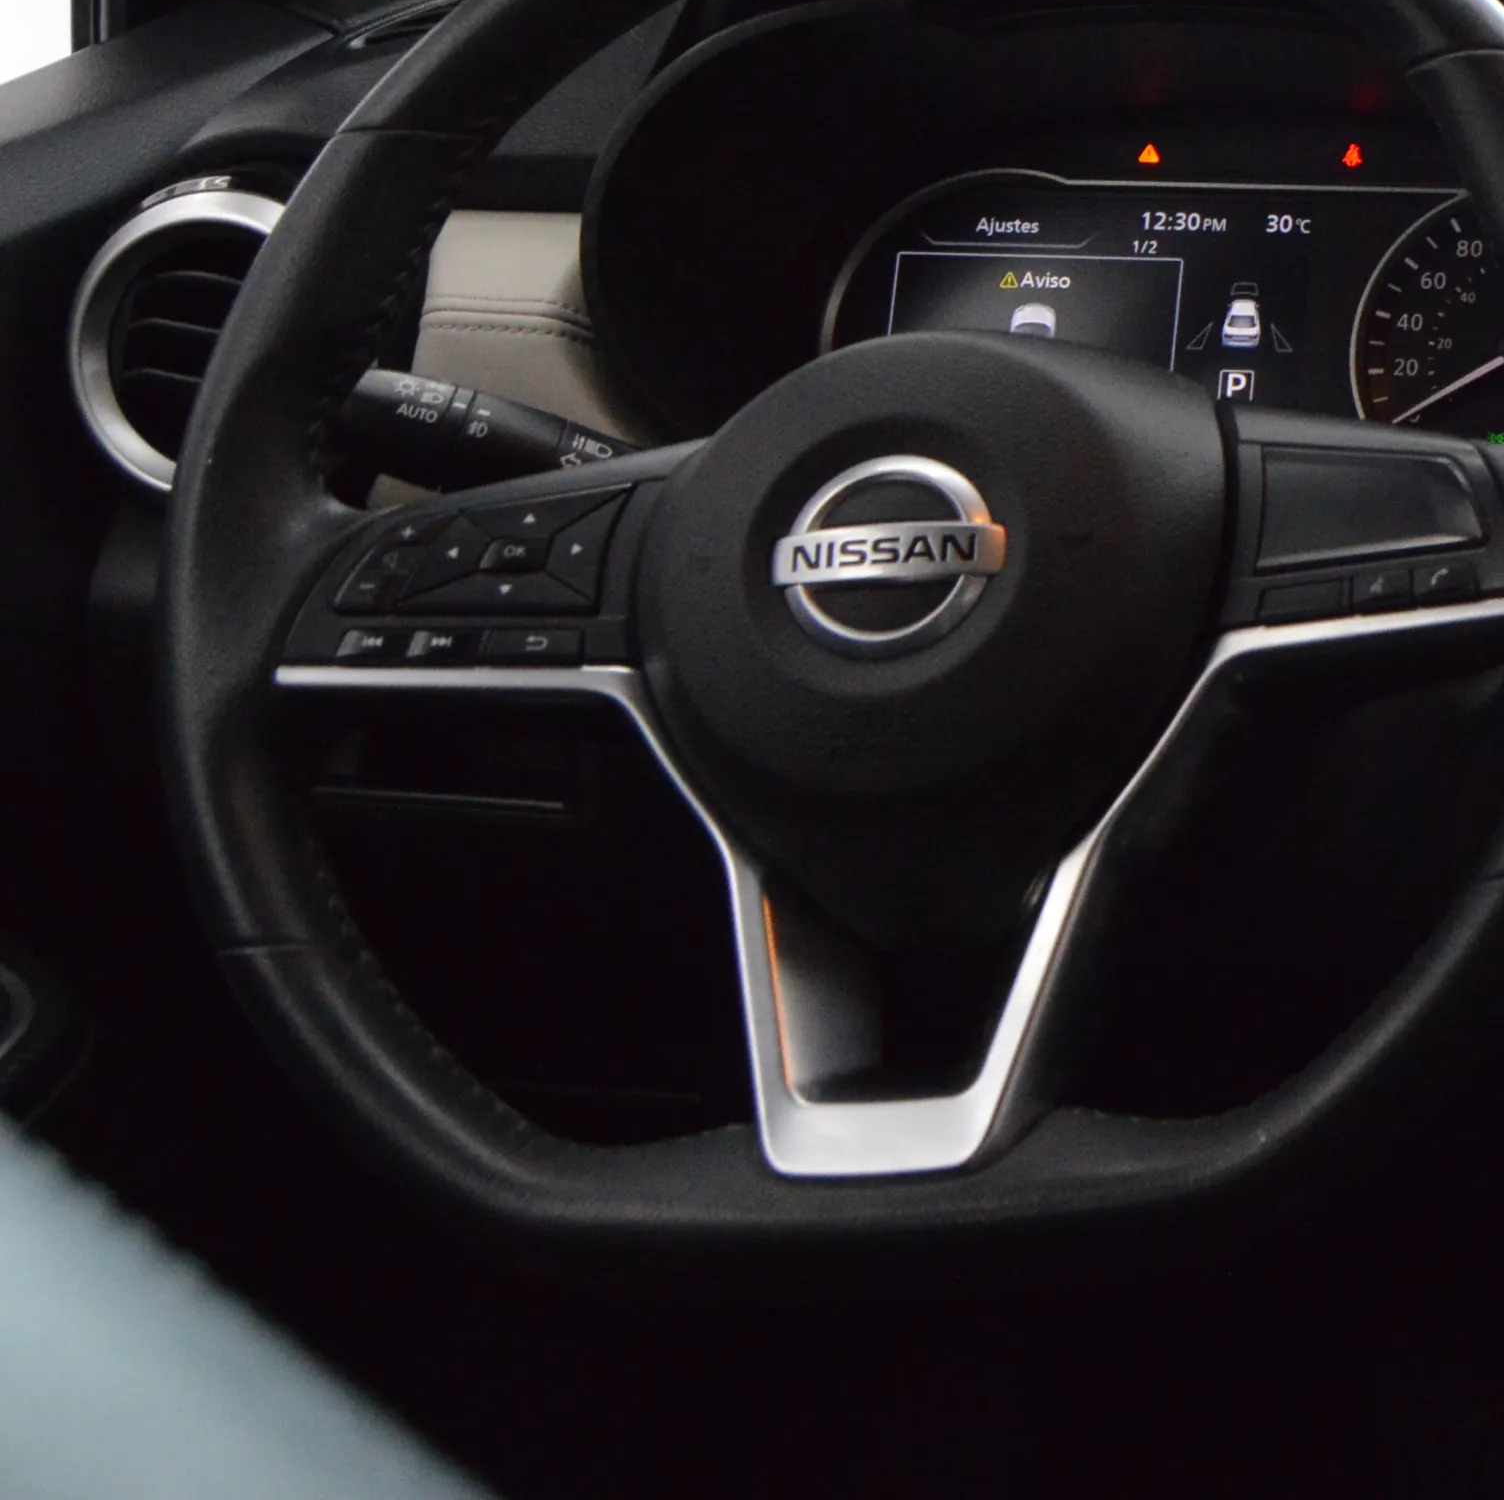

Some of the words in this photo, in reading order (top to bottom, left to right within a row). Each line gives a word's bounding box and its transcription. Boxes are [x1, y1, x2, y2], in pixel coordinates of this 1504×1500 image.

[975, 217, 1040, 235] Ajustes
[1132, 240, 1158, 255] 1/2
[1456, 240, 1483, 258] 80
[1020, 272, 1071, 290] Aviso
[1420, 272, 1447, 290] 60
[1460, 292, 1476, 304] 40
[1397, 313, 1423, 332] 40
[1437, 338, 1452, 350] 20
[1394, 358, 1418, 377] 20
[1226, 373, 1247, 395] P
[396, 403, 439, 424] AUTO
[504, 544, 526, 558] OK
[791, 532, 977, 573] NISSAN
